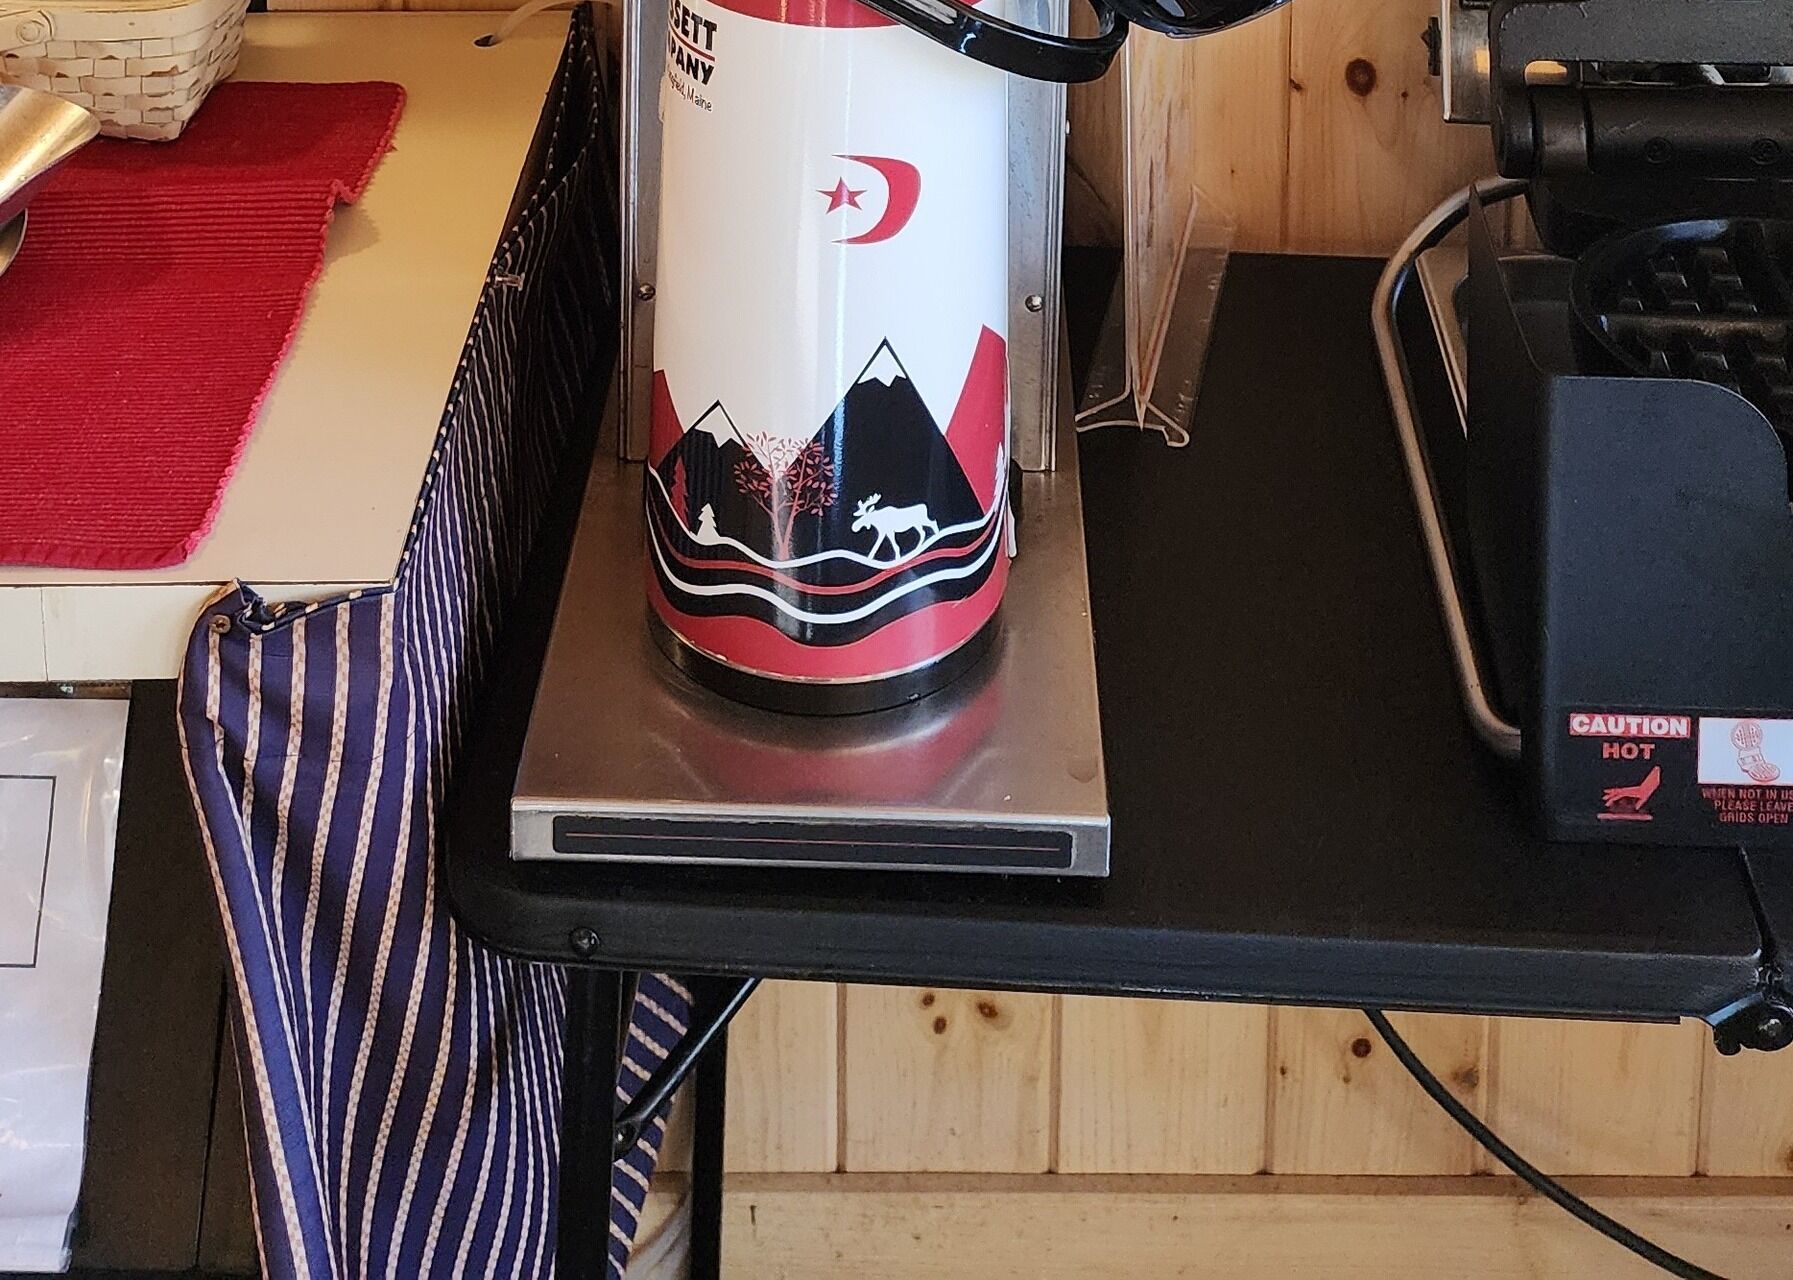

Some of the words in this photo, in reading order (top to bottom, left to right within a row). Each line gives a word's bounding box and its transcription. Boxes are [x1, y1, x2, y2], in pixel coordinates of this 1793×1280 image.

[668, 30, 714, 85] PANY
[1571, 716, 1688, 736] CAUTION
[1603, 742, 1655, 760] HOT
[1702, 788, 1735, 798] WHEN
[1739, 789, 1760, 799] NOT
[1766, 789, 1777, 799] IN
[1715, 800, 1756, 811] PLEASE
[1760, 802, 1793, 812] LEAVE
[1759, 813, 1788, 823] OPEN
